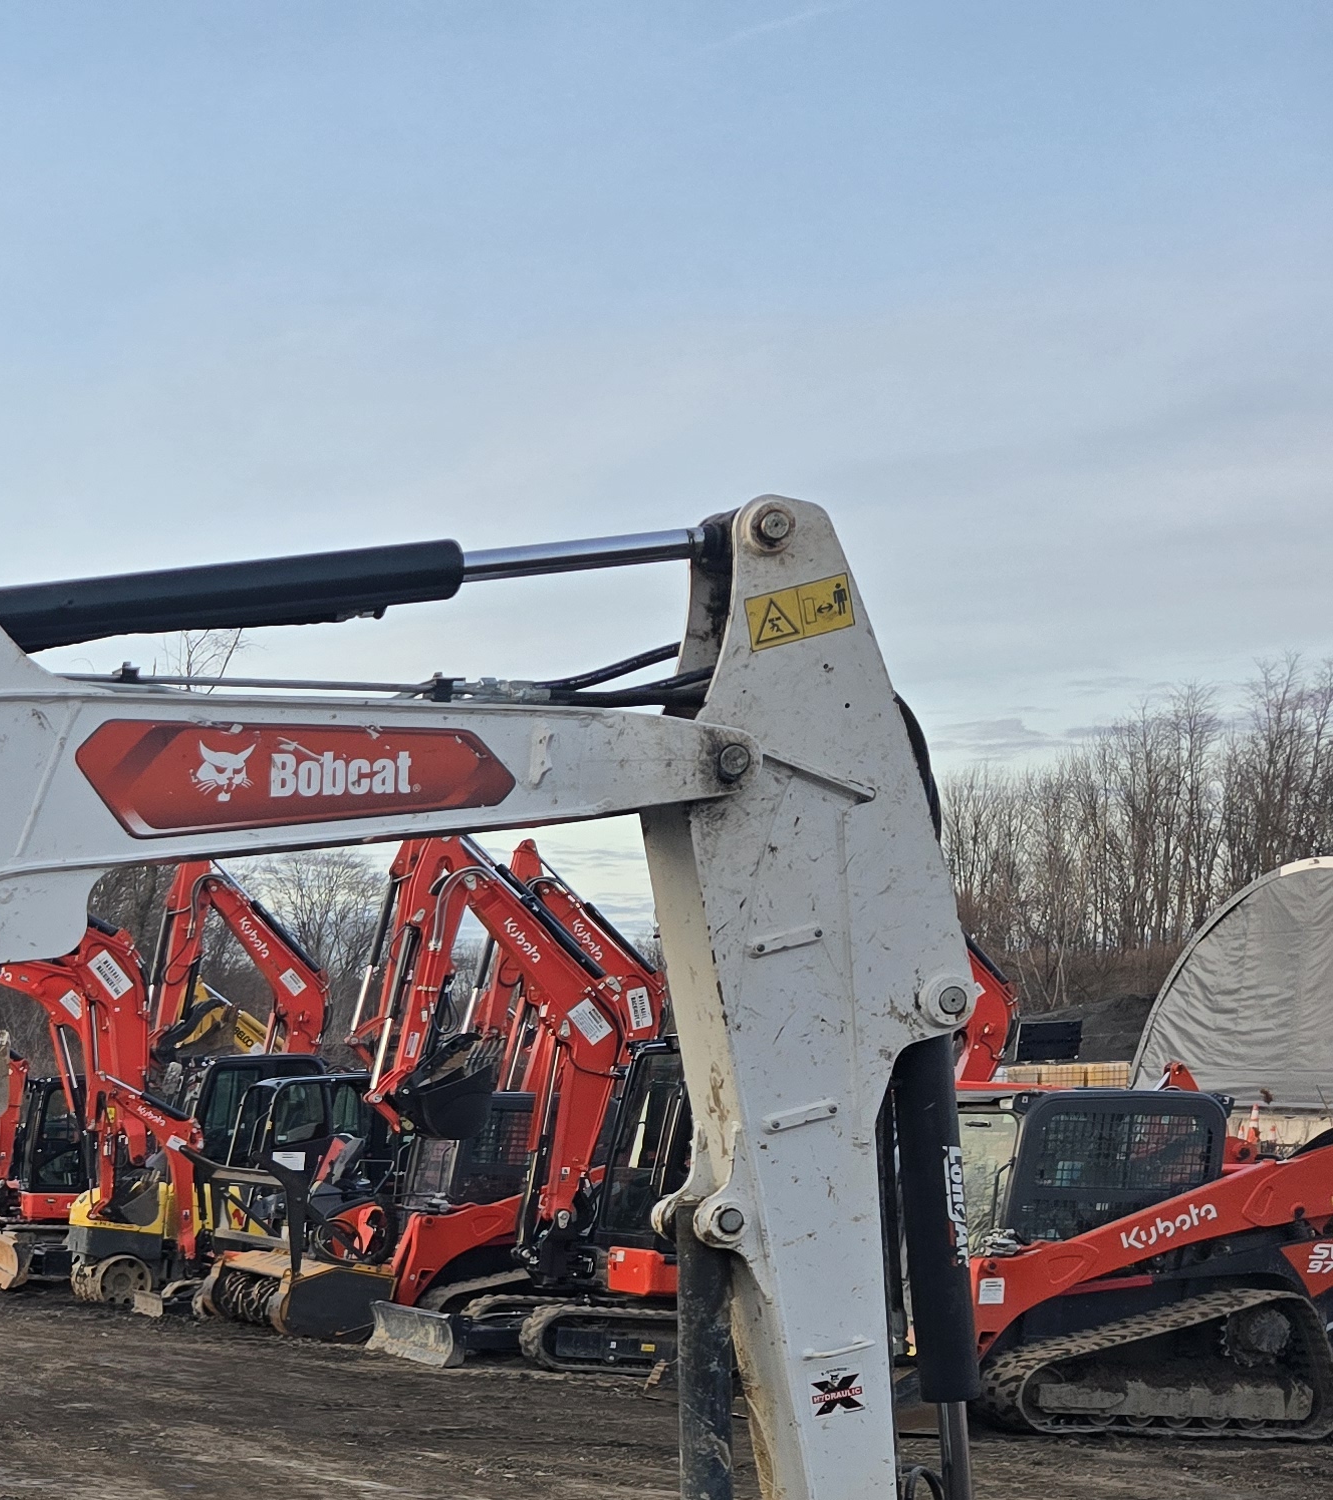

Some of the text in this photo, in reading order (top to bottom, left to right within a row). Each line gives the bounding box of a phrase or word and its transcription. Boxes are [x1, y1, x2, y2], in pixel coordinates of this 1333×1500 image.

[270, 751, 412, 798] Bobcat
[238, 916, 270, 959] Kubota
[504, 917, 541, 963] Kubota
[573, 919, 603, 961] Kubota
[234, 1026, 255, 1048] BELCO
[137, 1105, 166, 1127] Kubota
[1120, 1203, 1218, 1249] Kubota
